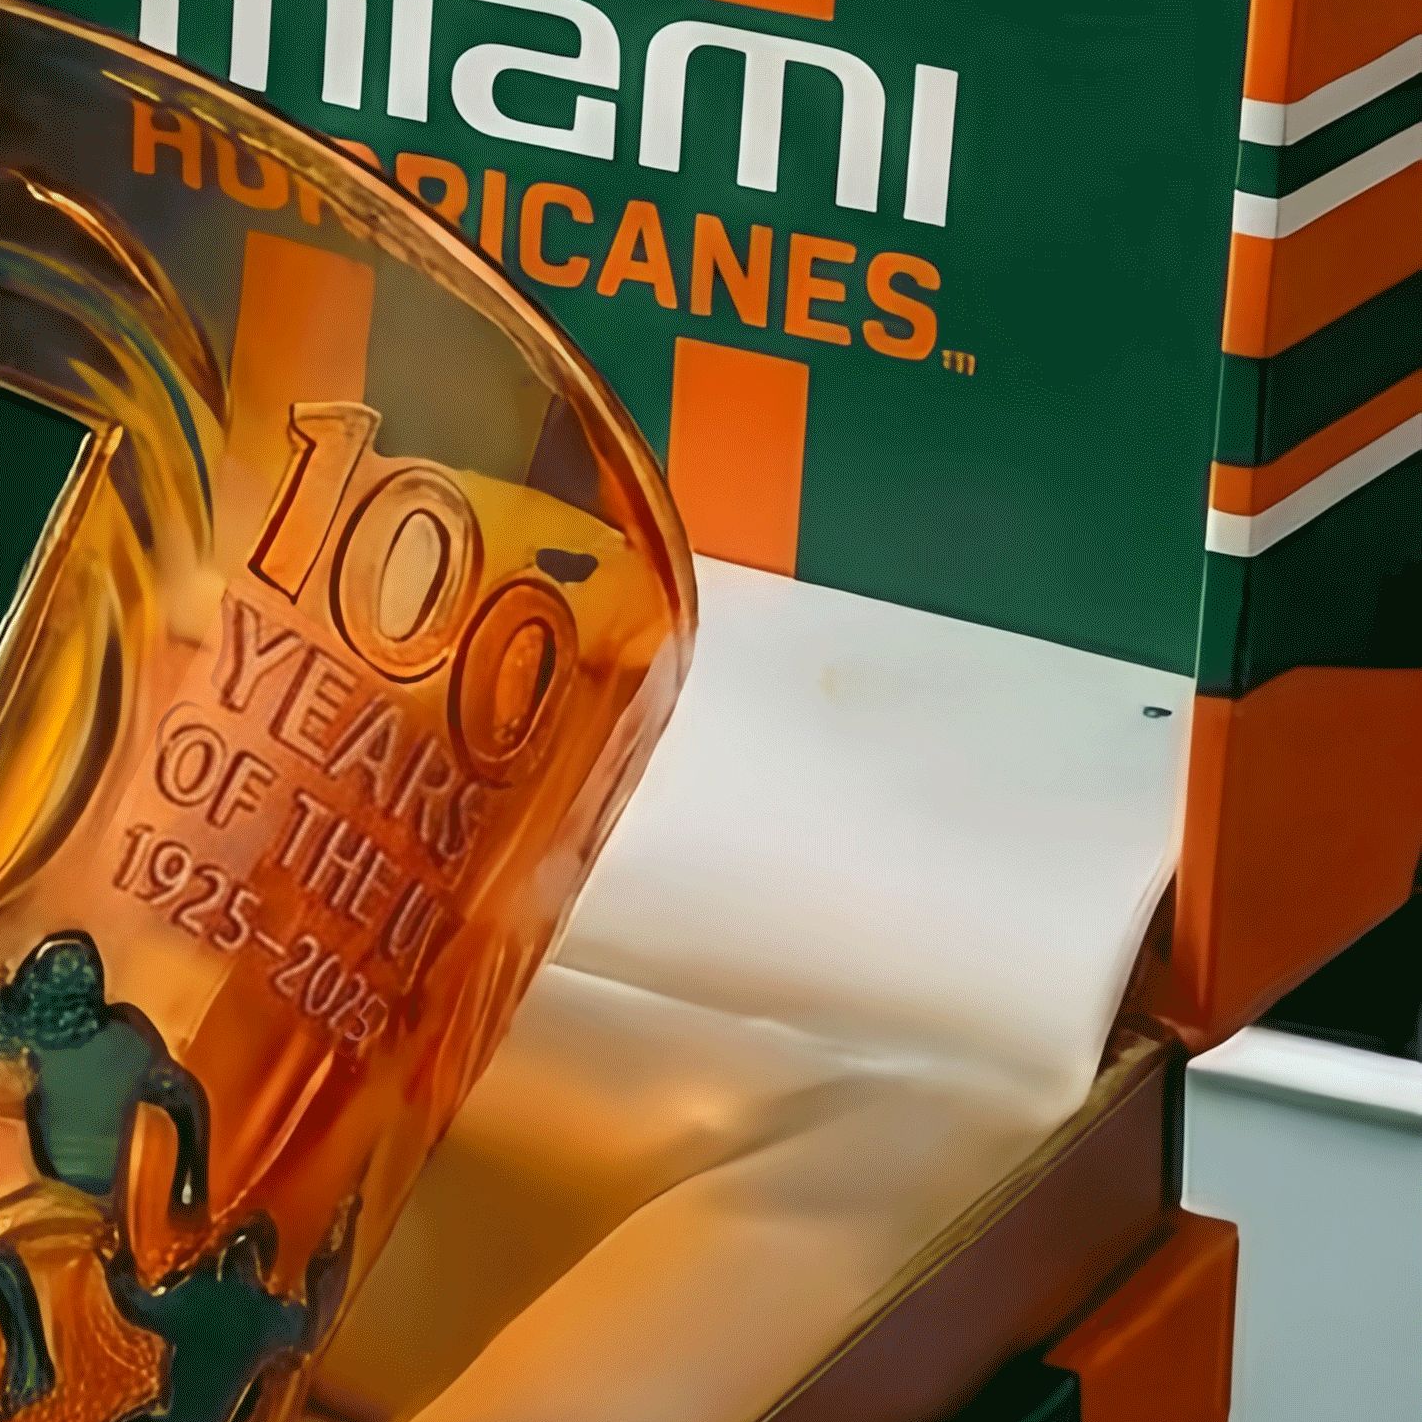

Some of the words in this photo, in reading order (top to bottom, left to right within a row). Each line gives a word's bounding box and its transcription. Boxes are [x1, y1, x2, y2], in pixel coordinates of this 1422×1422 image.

[247, 401, 579, 772] 100
[156, 724, 278, 829] OF
[277, 788, 401, 928] THE
[219, 598, 484, 868] YEARS
